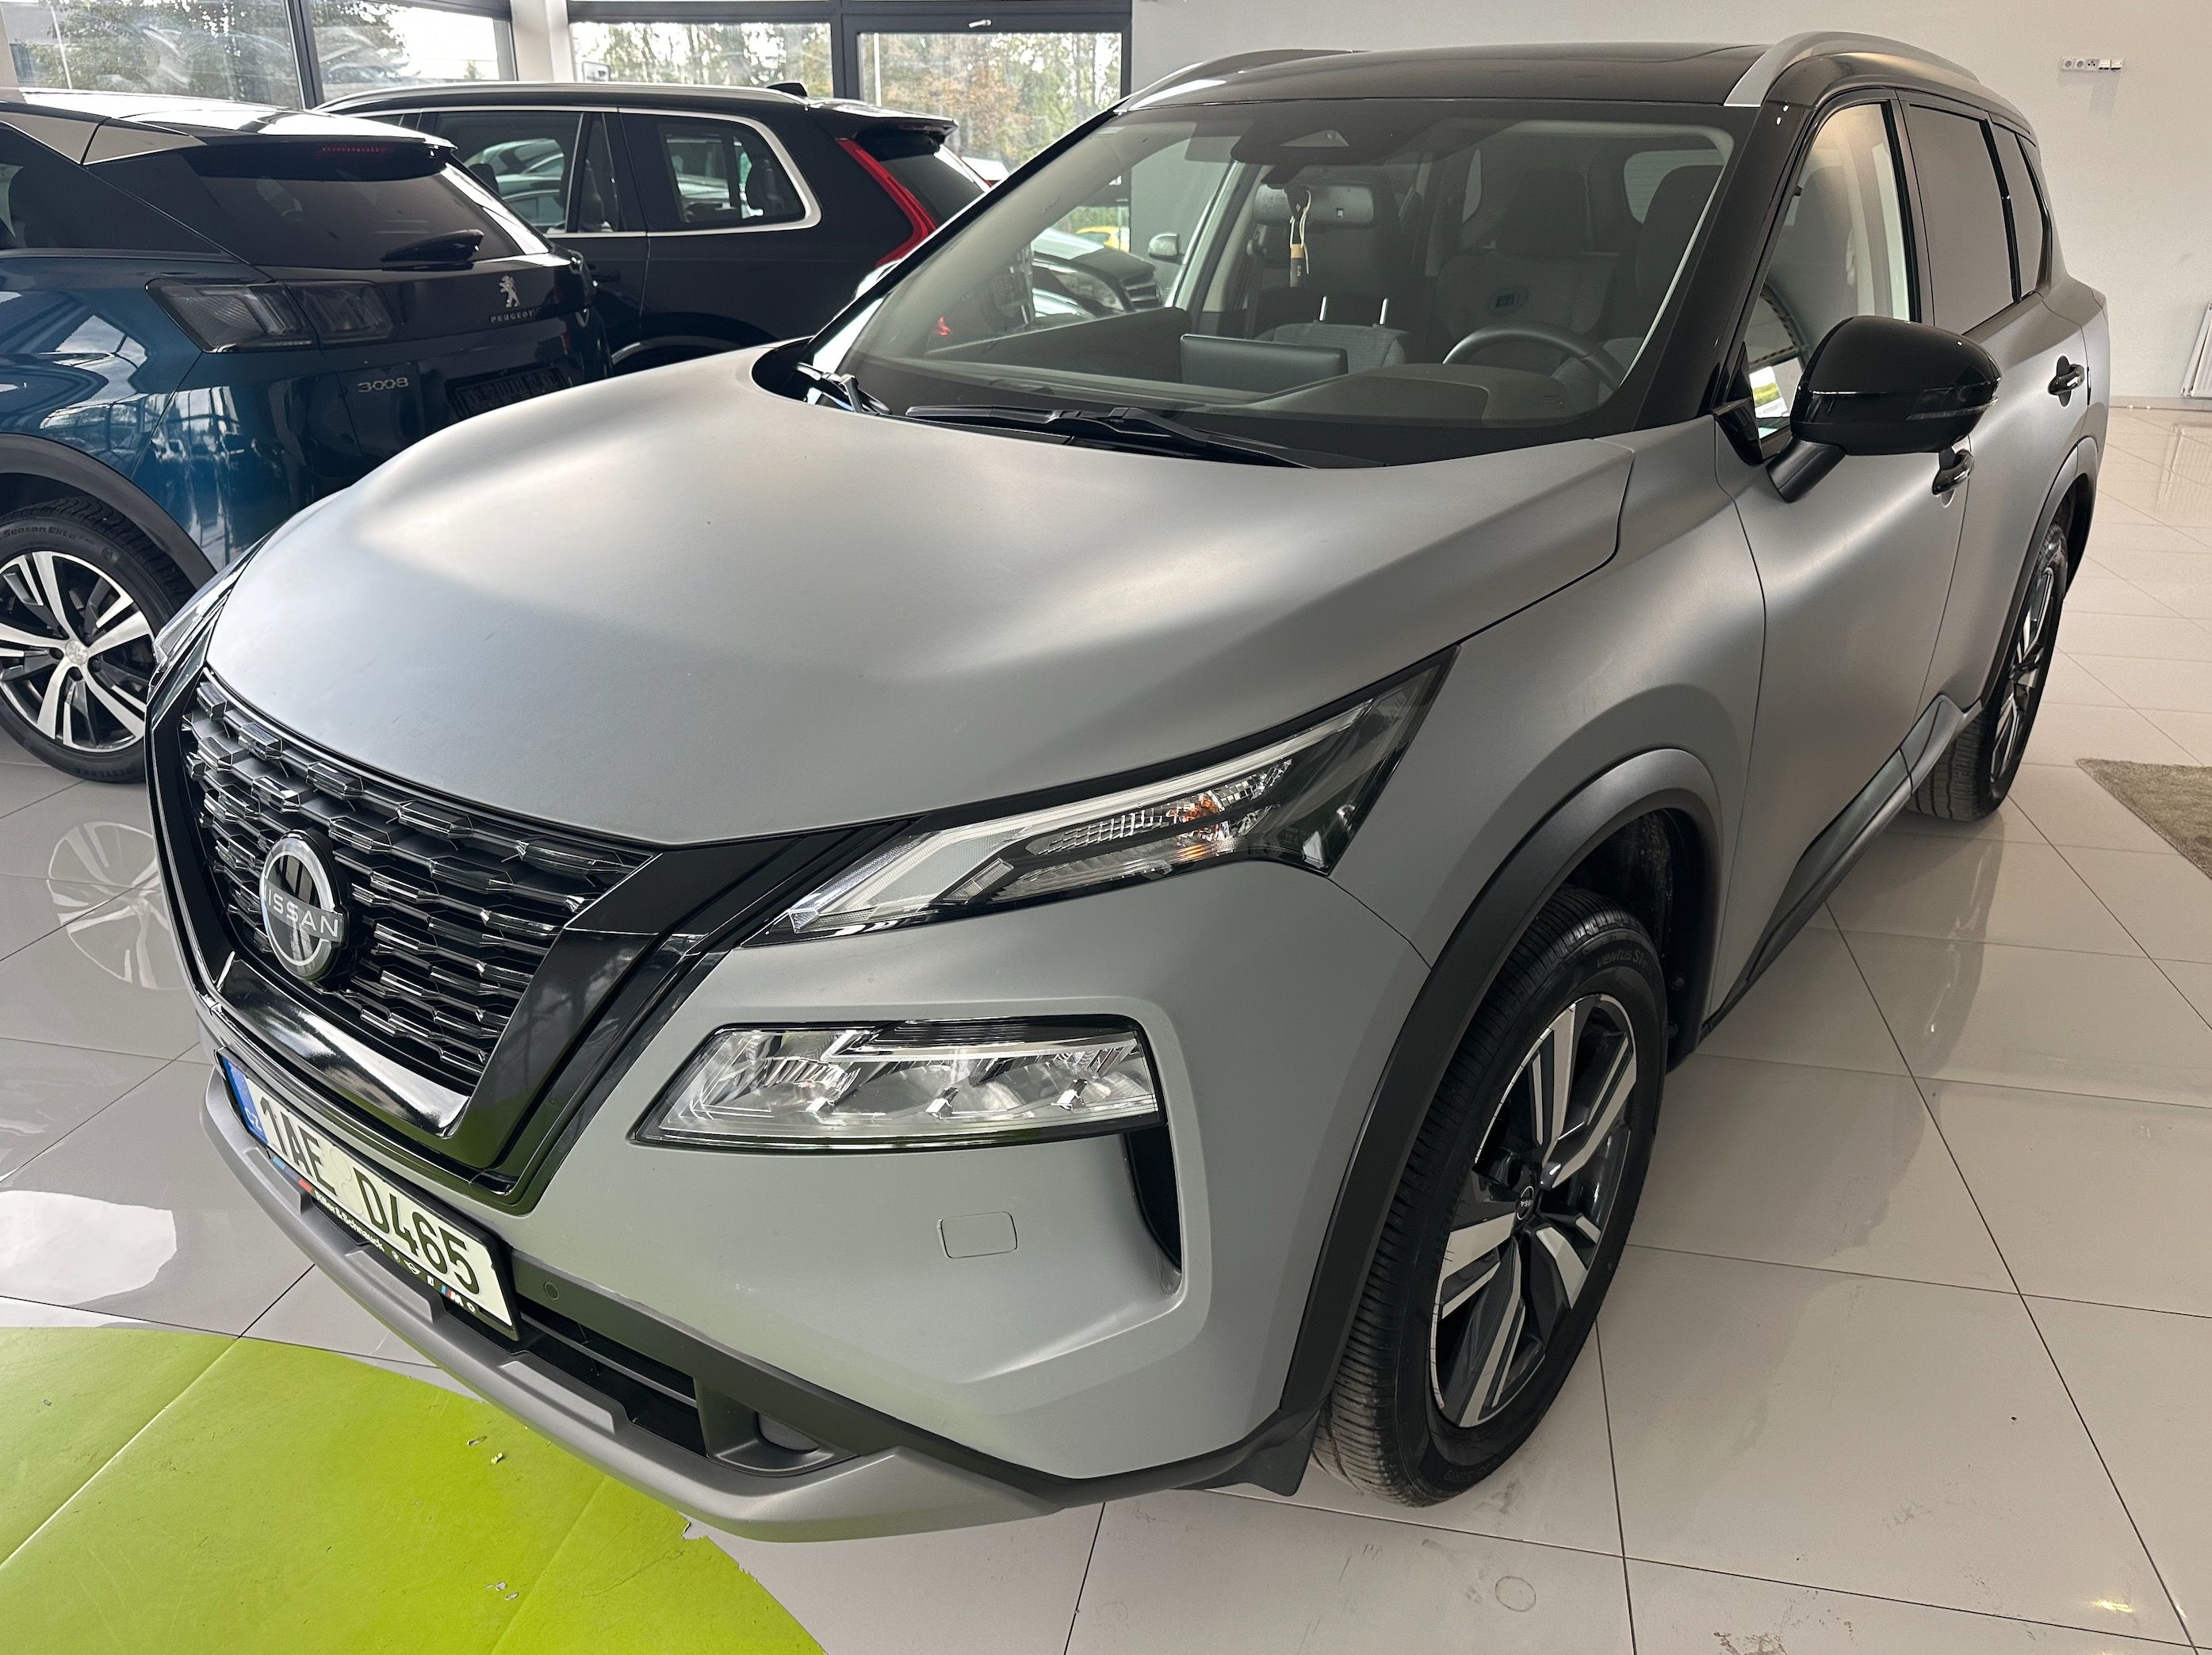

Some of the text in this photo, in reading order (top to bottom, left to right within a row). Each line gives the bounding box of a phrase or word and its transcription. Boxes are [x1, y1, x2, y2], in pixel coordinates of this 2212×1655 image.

[490, 310, 534, 323] PEUGEOT
[358, 377, 408, 392] 3008
[244, 1107, 262, 1132] CZ
[260, 1096, 480, 1295] 1AE D465
